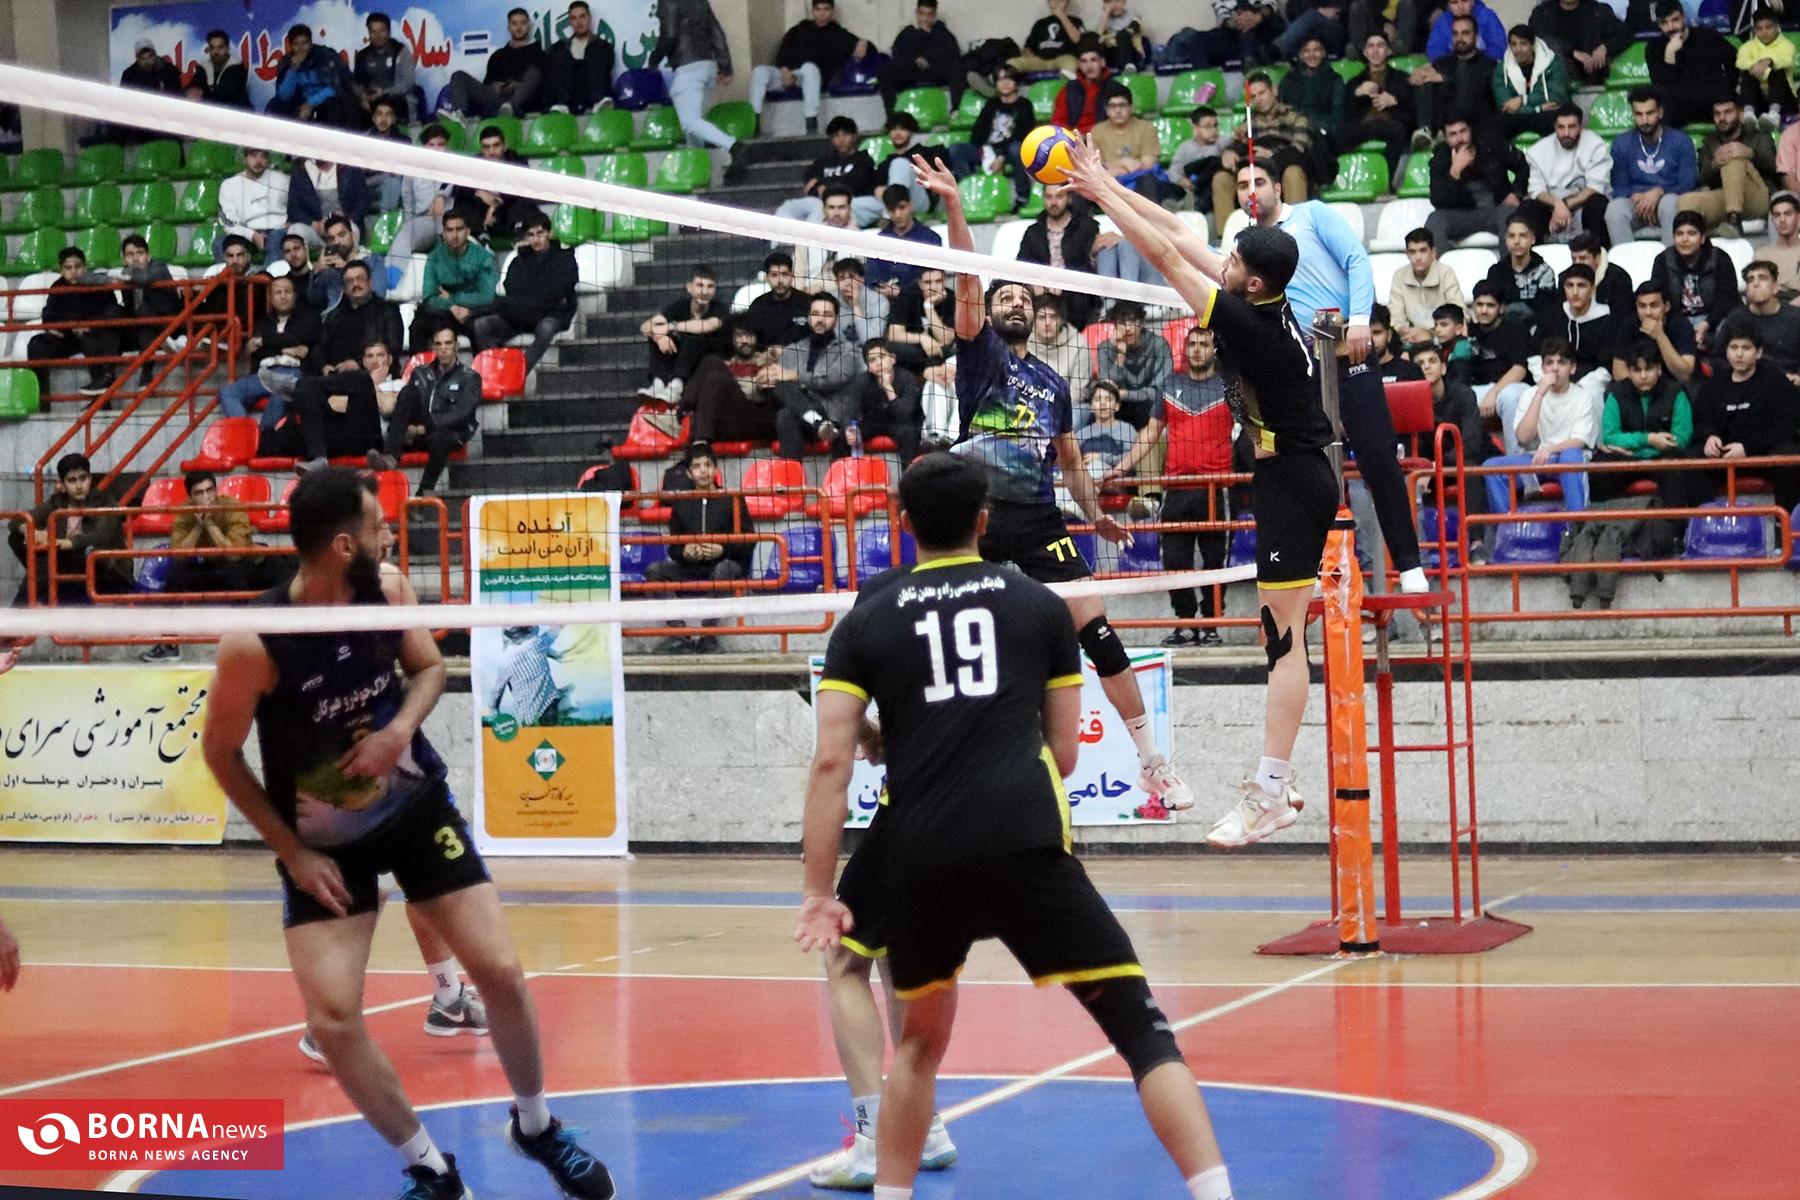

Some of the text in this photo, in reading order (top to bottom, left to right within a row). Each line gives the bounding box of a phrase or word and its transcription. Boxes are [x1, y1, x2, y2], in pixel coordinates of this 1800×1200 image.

[1012, 404, 1036, 428] 77
[517, 512, 573, 538] آینده
[497, 537, 594, 558] از آن من است
[1046, 536, 1078, 563] 77
[954, 580, 980, 598] مهندسی
[915, 607, 998, 703] 19
[5, 685, 207, 764] مجتمع آموزشی سرای
[3, 774, 163, 789] پسران و دختران متوسطه اول
[1068, 771, 1132, 807] حامی
[434, 826, 465, 860] 3
